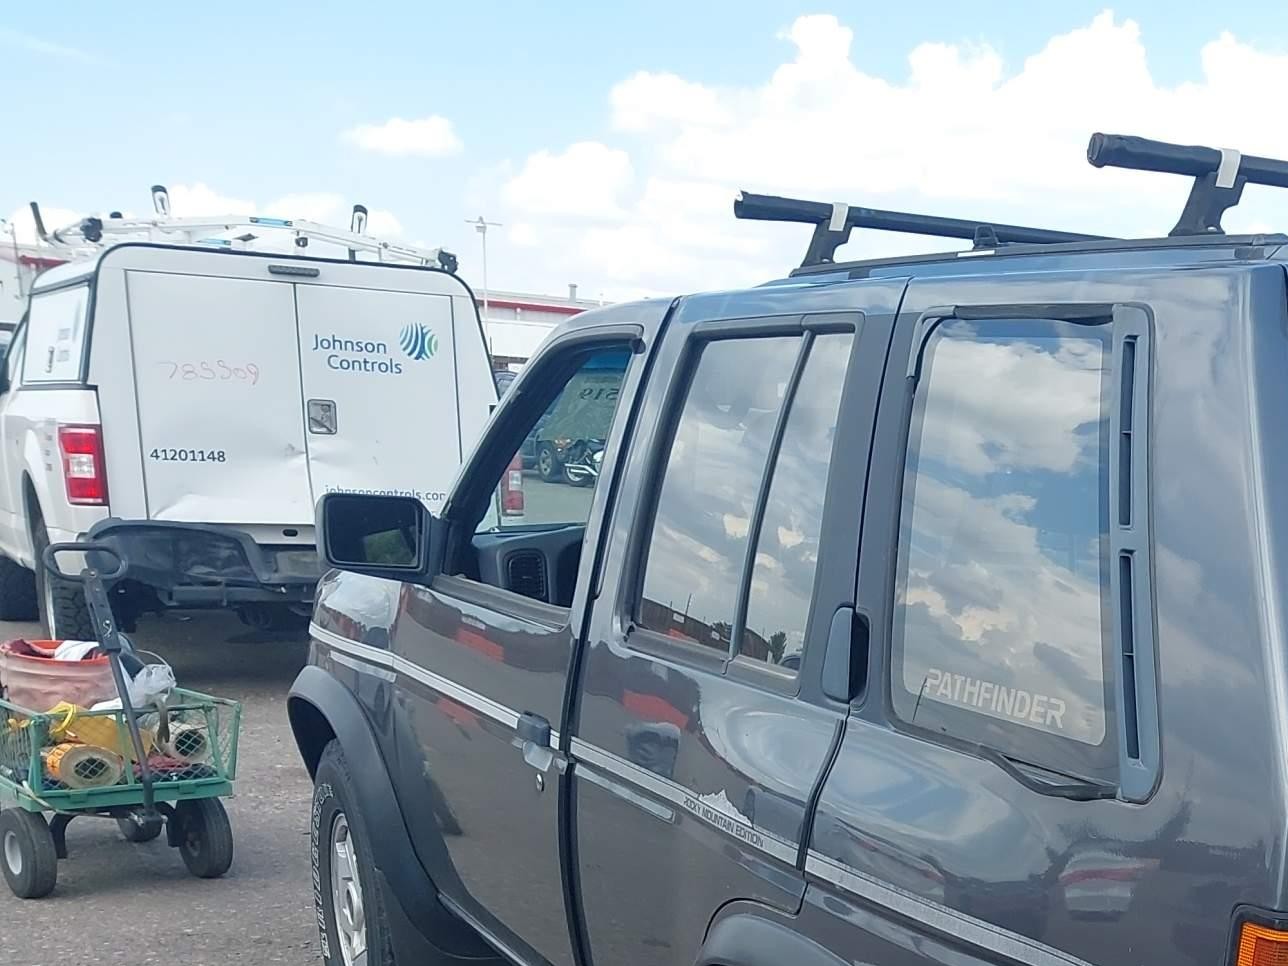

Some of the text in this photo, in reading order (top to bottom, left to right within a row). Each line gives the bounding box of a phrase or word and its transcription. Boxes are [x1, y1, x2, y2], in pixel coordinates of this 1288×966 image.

[312, 334, 387, 354] Johnson
[327, 354, 402, 374] Controls
[149, 448, 227, 462] 41201148
[924, 667, 1066, 729] PATHFINDER
